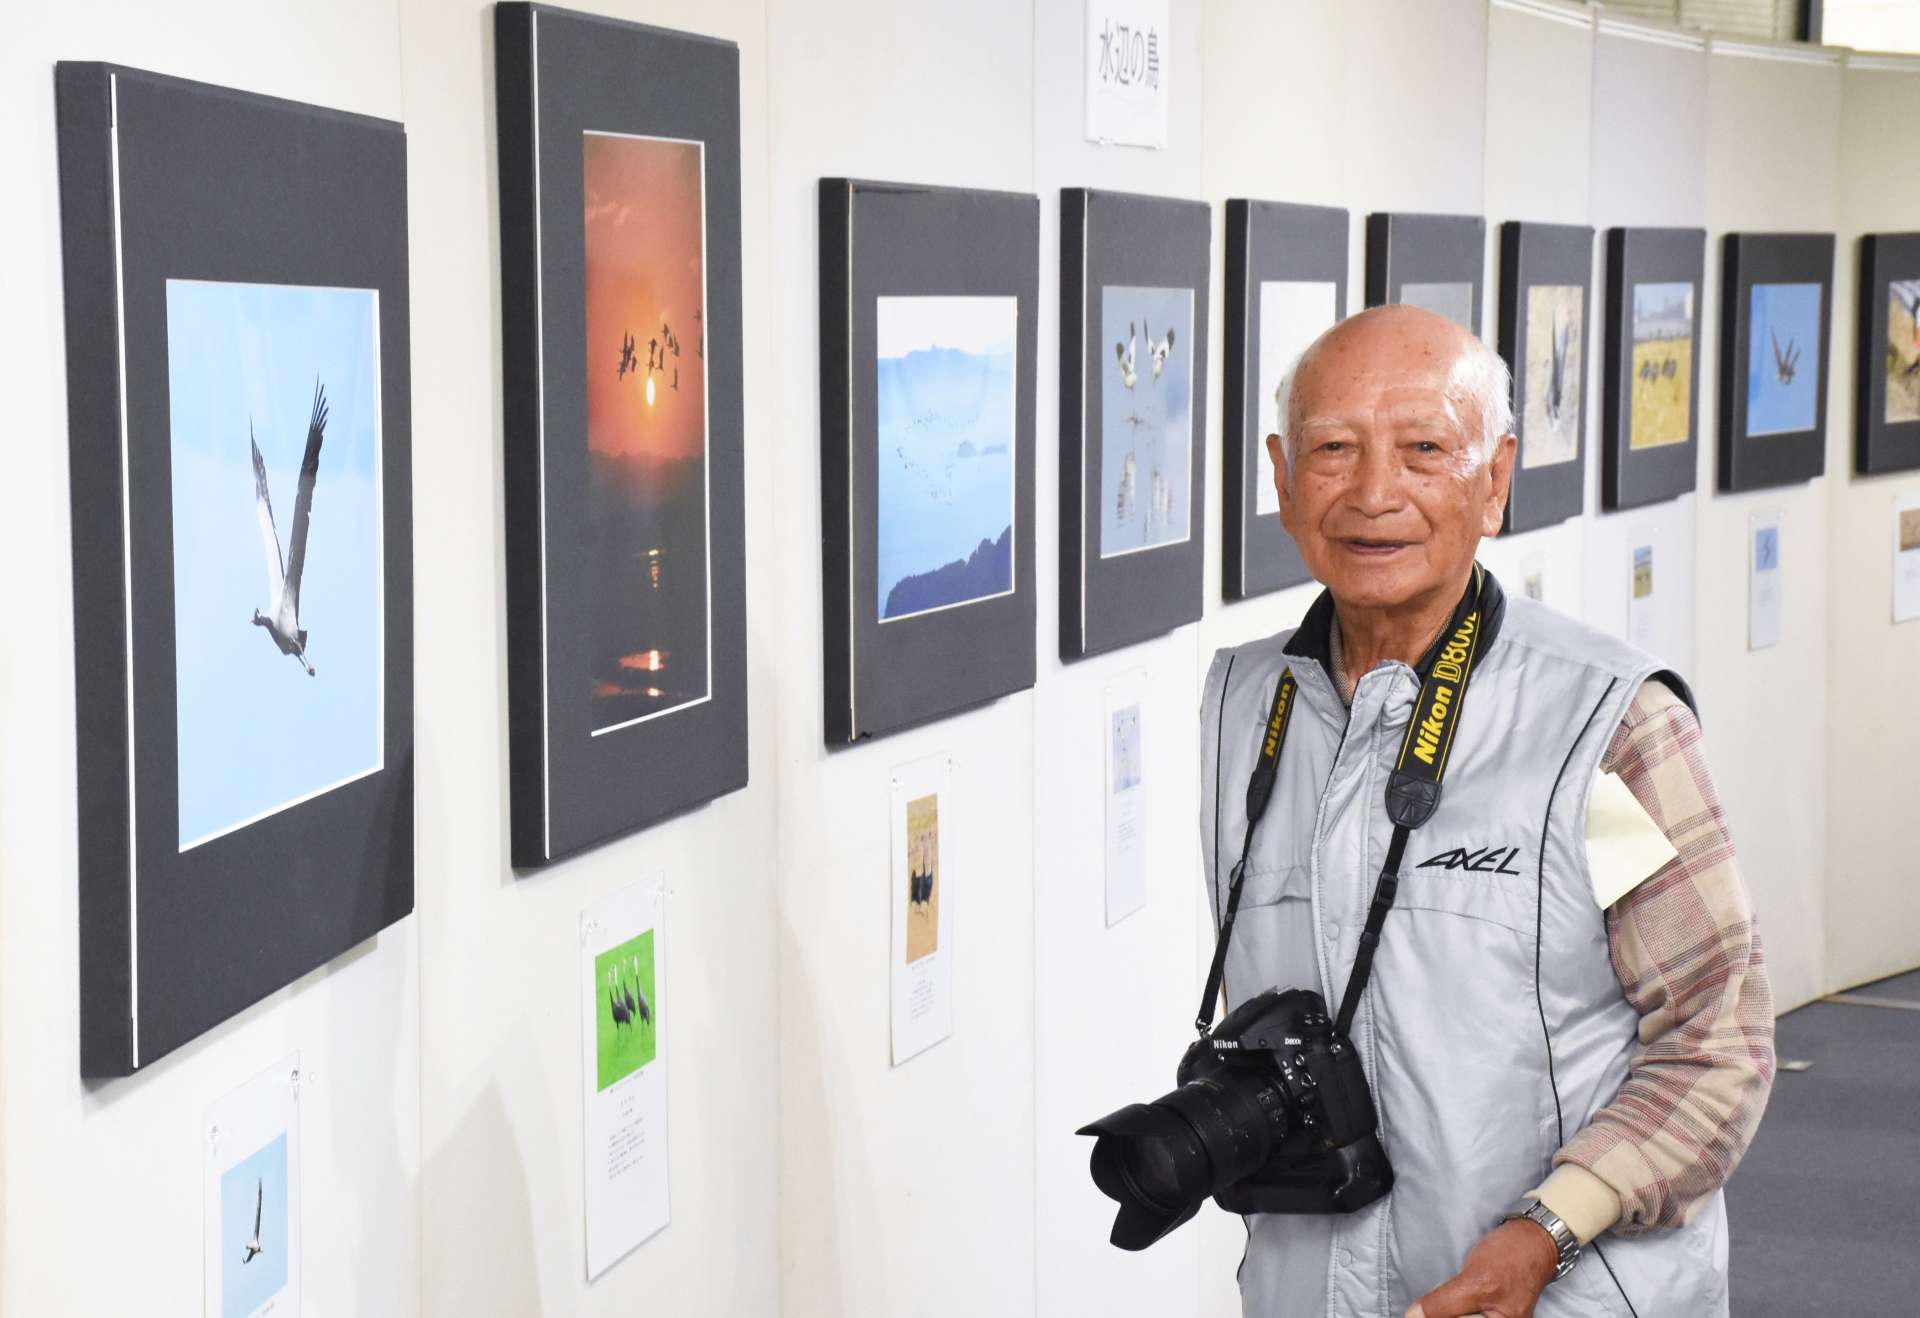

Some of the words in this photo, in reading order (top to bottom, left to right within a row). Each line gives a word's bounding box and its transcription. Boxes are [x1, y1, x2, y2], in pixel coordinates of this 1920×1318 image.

[1098, 17, 1159, 91] 水辺の鳥
[1264, 683, 1291, 757] Nikon
[1413, 686, 1453, 765] Nikon
[1415, 846, 1521, 875] AXEL
[1213, 1039, 1239, 1049] Nikon
